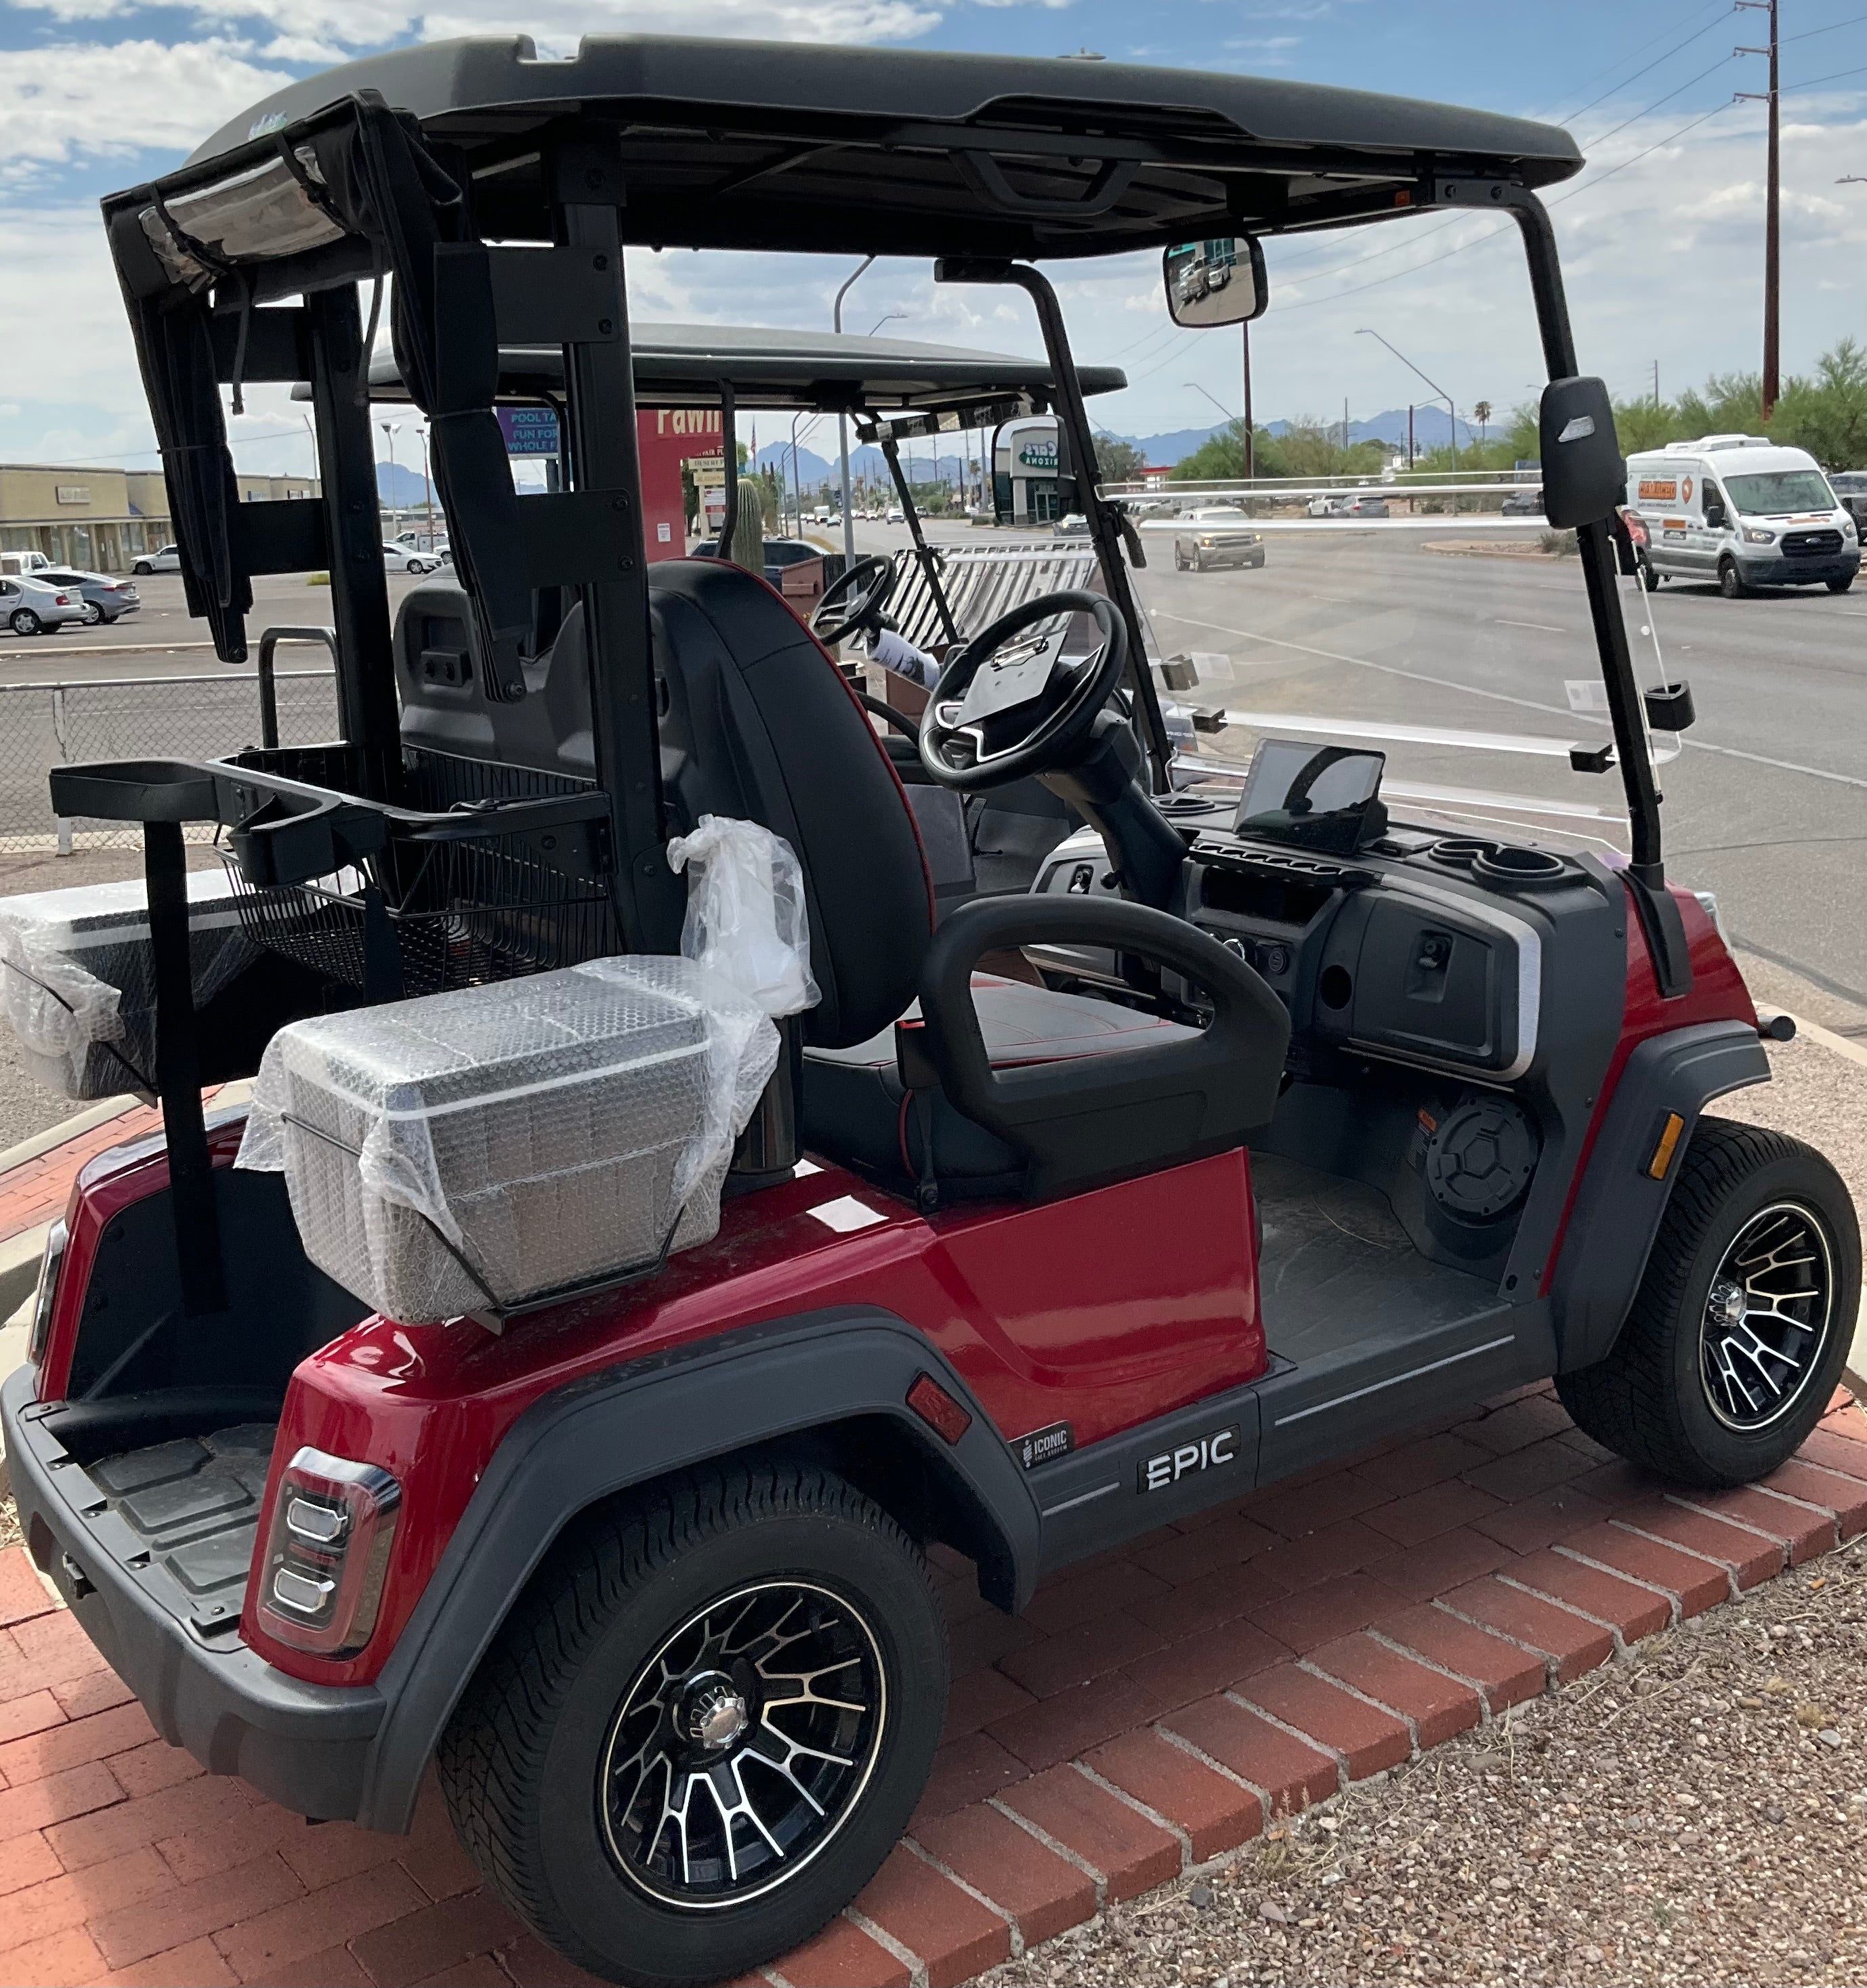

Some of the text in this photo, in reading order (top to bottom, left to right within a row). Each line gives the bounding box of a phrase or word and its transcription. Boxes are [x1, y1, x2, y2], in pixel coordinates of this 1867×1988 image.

[511, 413, 541, 423] POOL
[513, 430, 535, 439] FUN
[1034, 1430, 1067, 1455] ICONIC
[1146, 1431, 1234, 1490] EPIC
